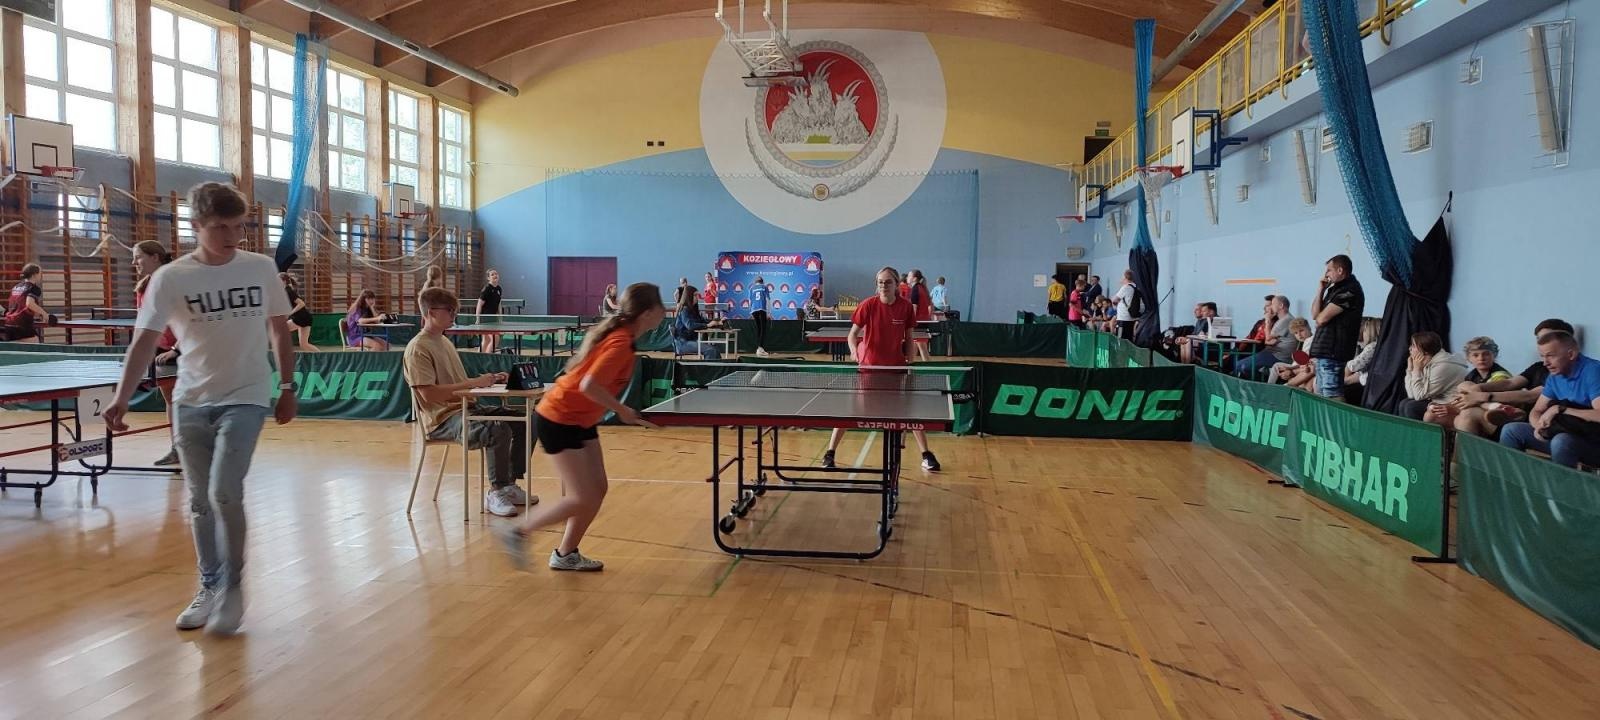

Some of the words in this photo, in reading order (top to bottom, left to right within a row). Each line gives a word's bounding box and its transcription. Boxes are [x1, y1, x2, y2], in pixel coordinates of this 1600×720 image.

[743, 255, 798, 263] KOZIEGŁOWY
[184, 286, 262, 314] HUGO
[271, 372, 389, 400] NIC
[92, 399, 101, 416] 2
[990, 384, 1184, 421] DONIC
[900, 422, 925, 430] PLUS
[1207, 394, 1289, 450] DONIC
[1301, 430, 1409, 522] TIBHAR
